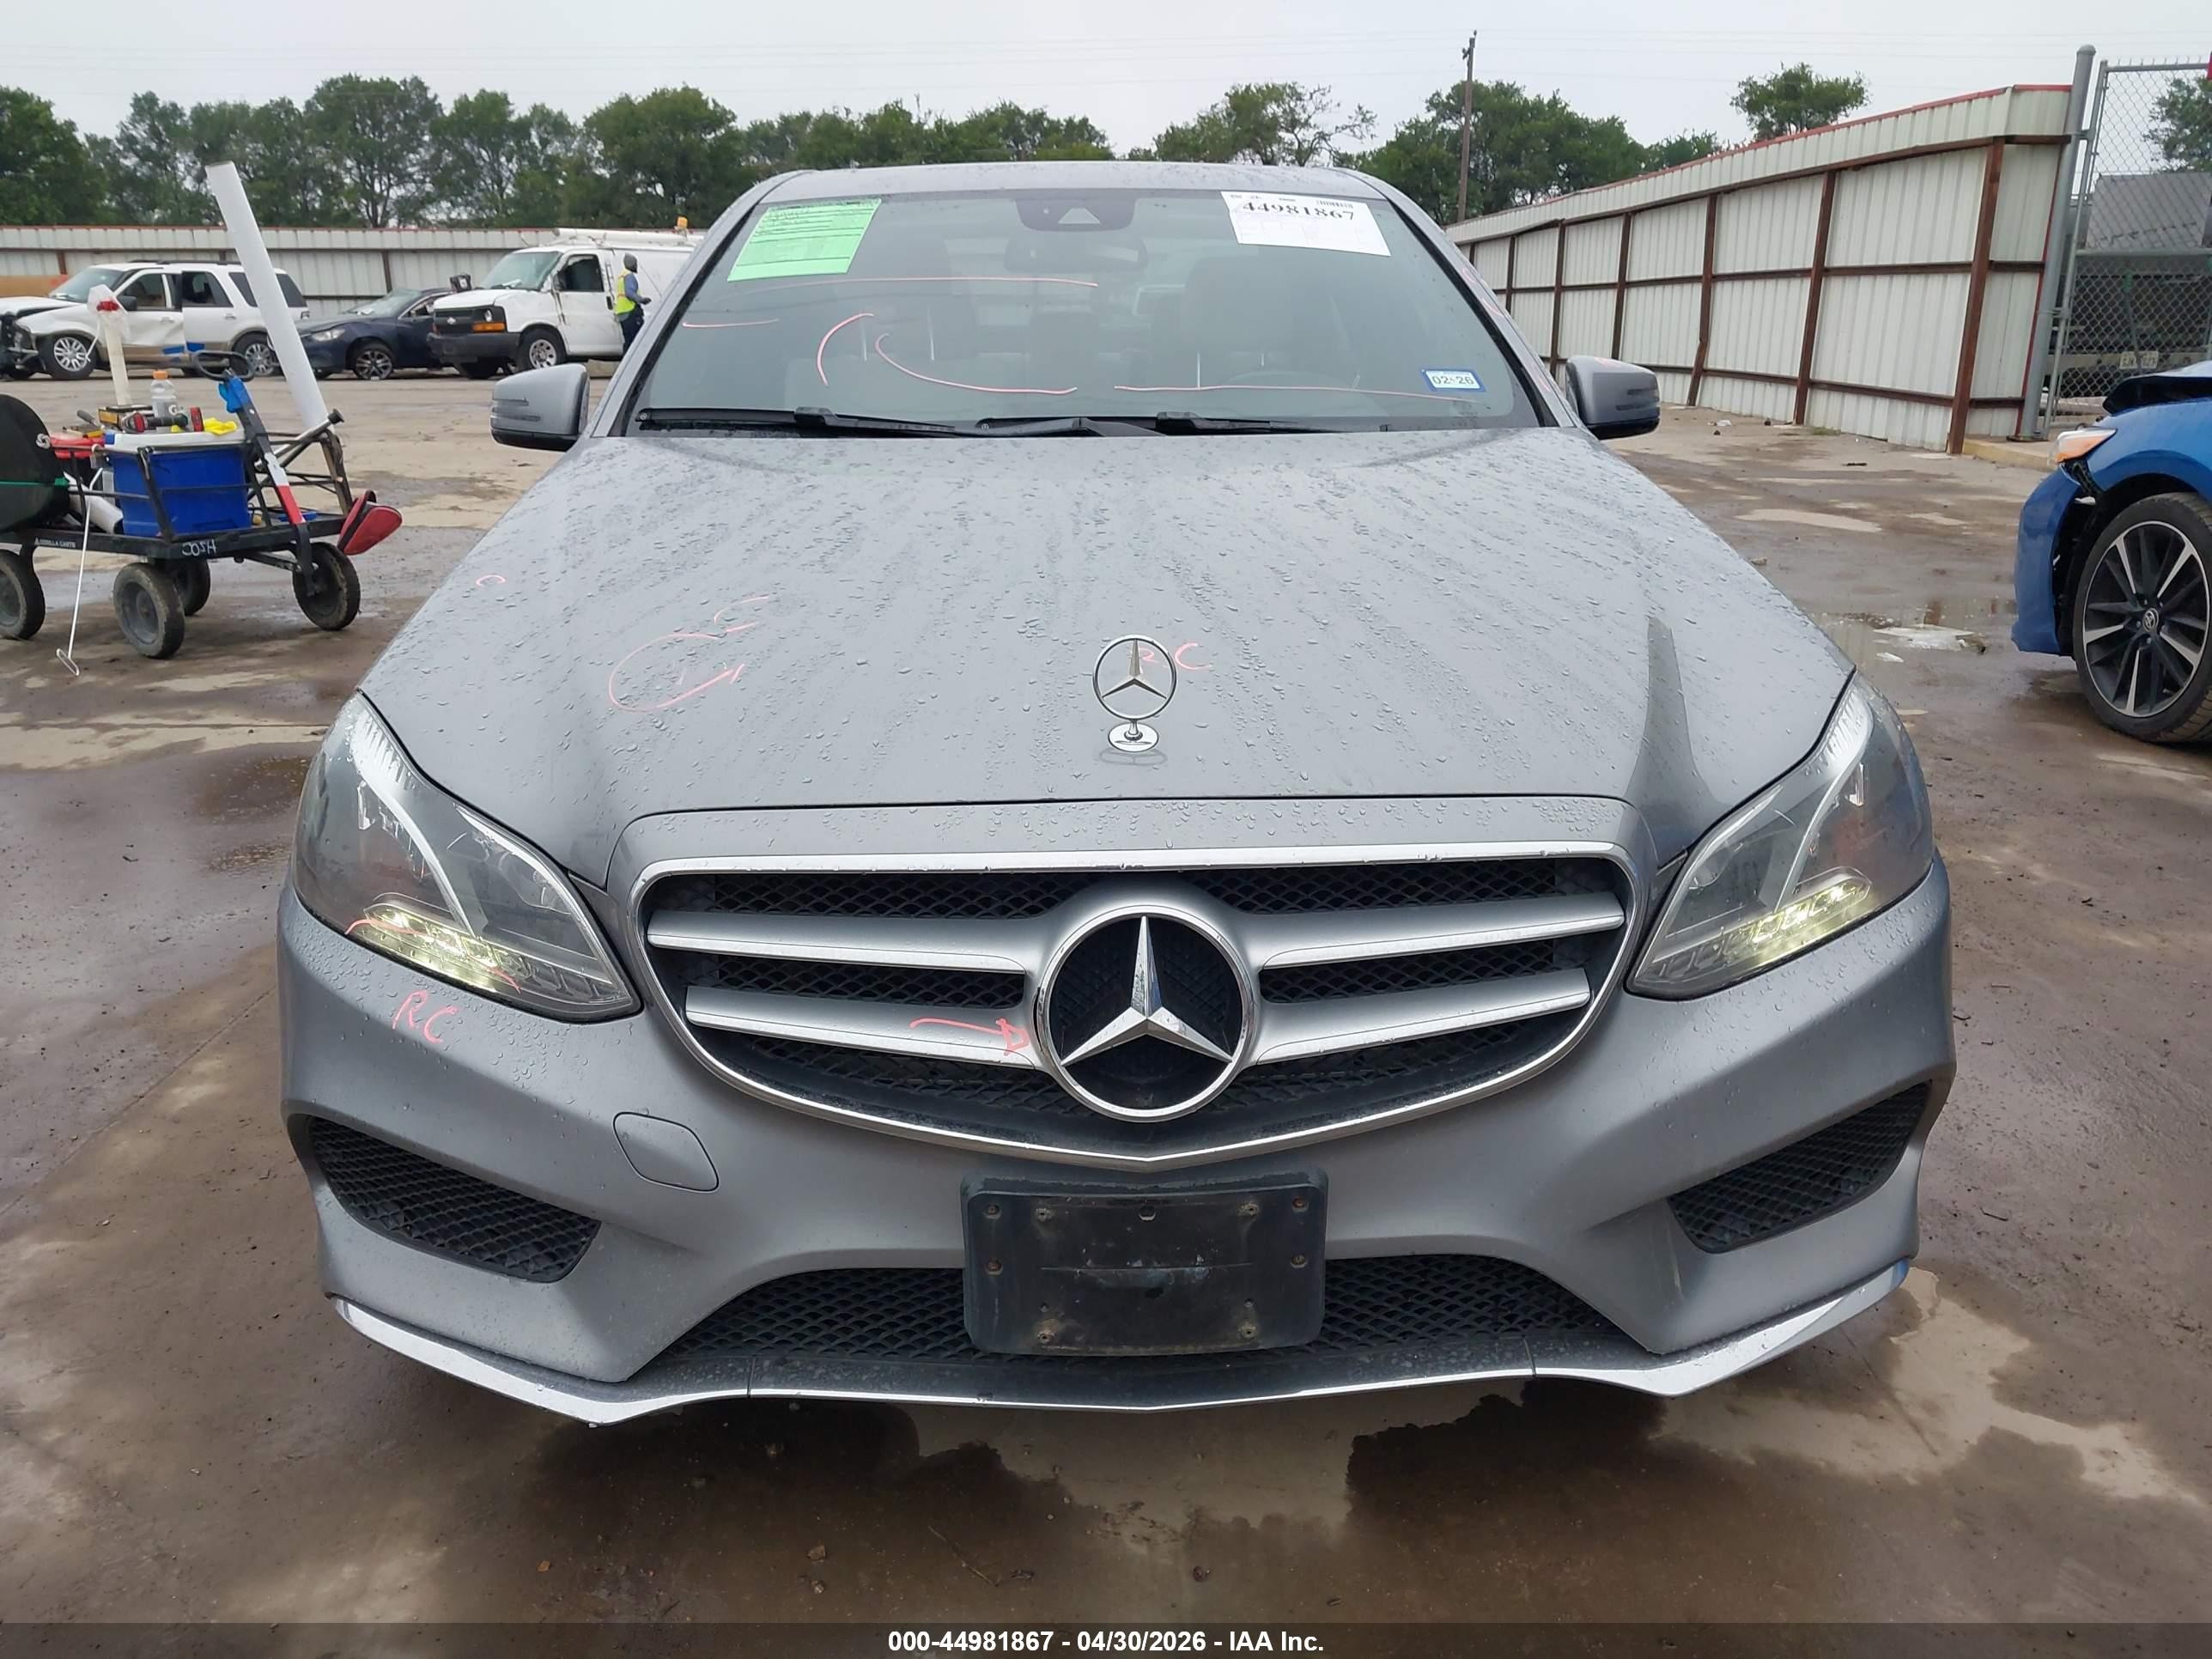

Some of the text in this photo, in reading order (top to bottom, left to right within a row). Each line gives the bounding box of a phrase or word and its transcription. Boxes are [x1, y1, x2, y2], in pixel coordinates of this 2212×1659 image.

[1243, 202, 1354, 221] 44981867
[1431, 375, 1475, 385] 02-26
[392, 990, 458, 1044] RC
